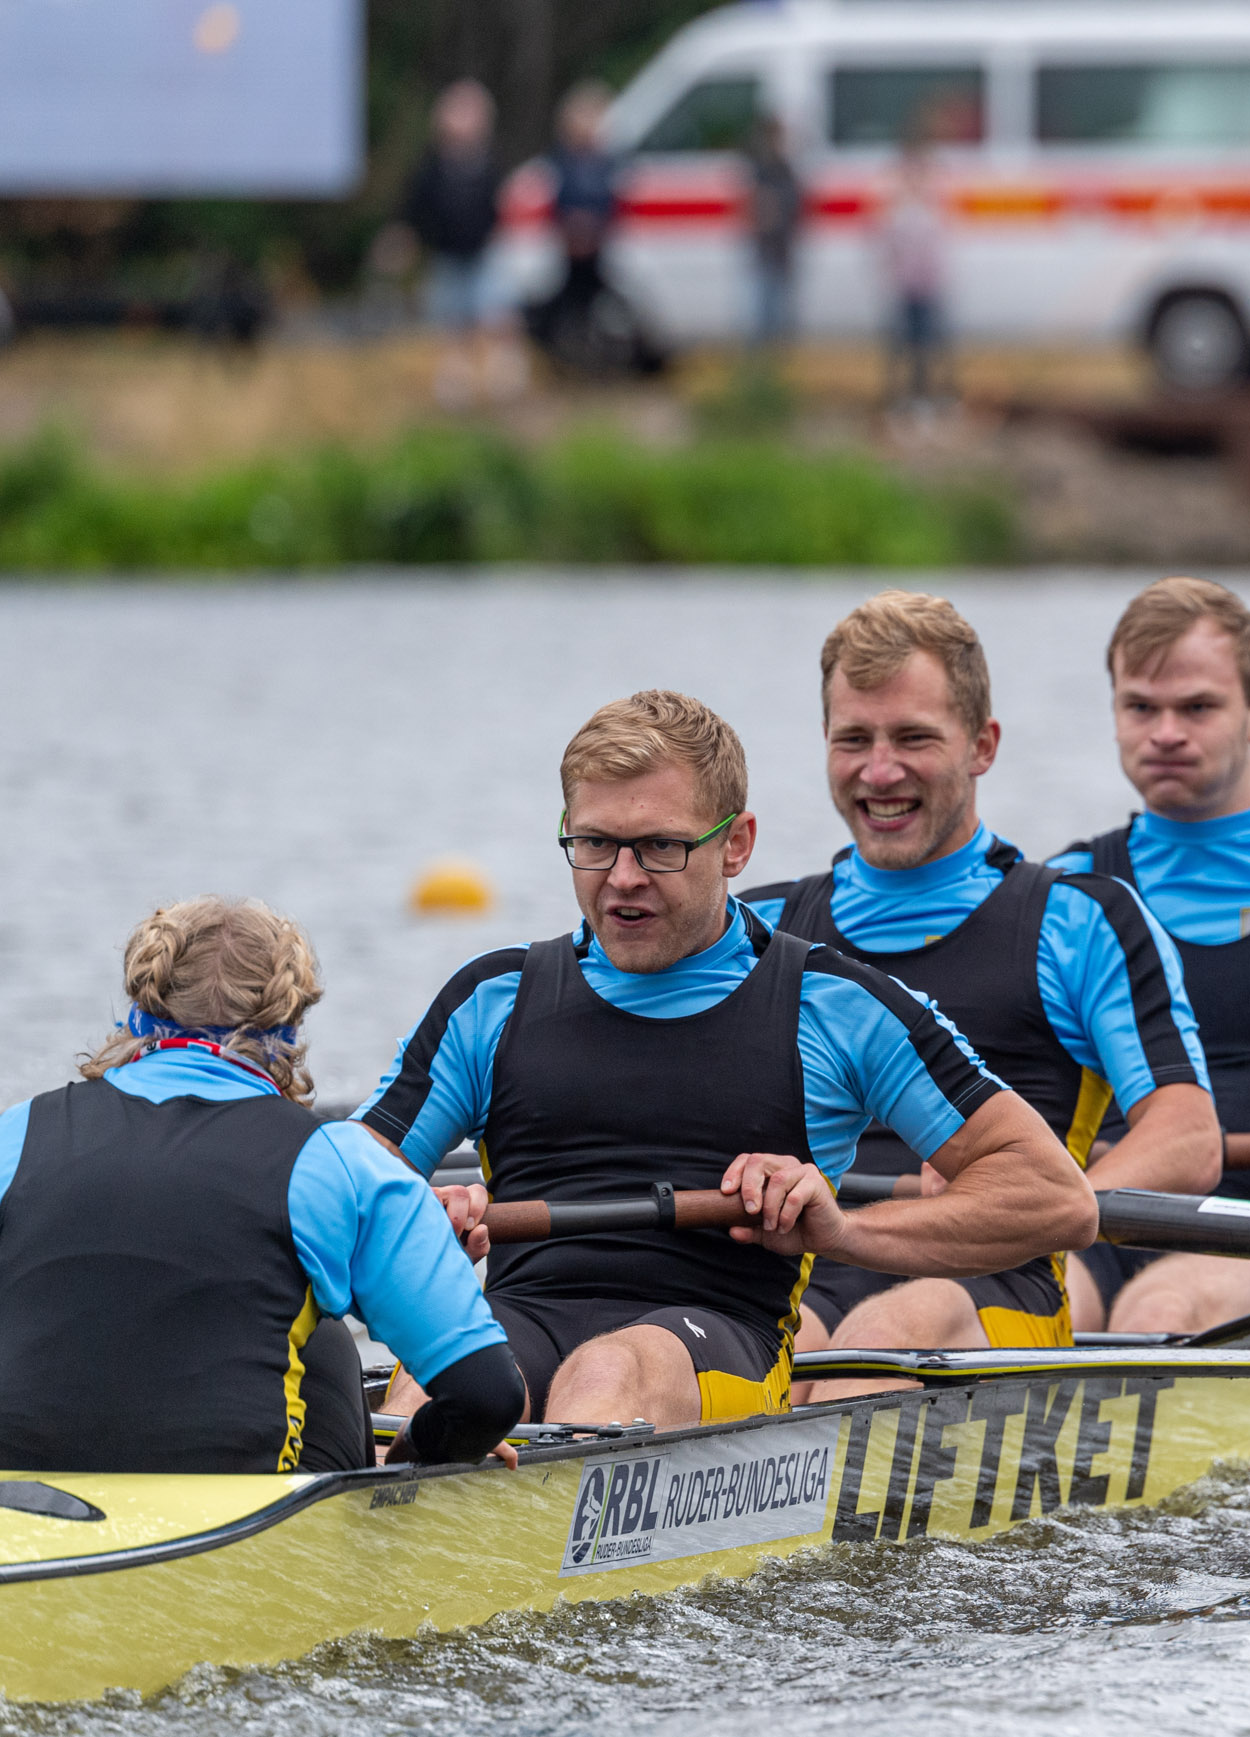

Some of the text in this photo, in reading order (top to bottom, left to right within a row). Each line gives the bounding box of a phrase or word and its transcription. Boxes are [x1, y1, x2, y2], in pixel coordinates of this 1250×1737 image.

[600, 1458, 661, 1538] RBL
[662, 1446, 829, 1529] RUDER-BUNDESLIGA
[831, 1376, 1175, 1543] LIFTKET
